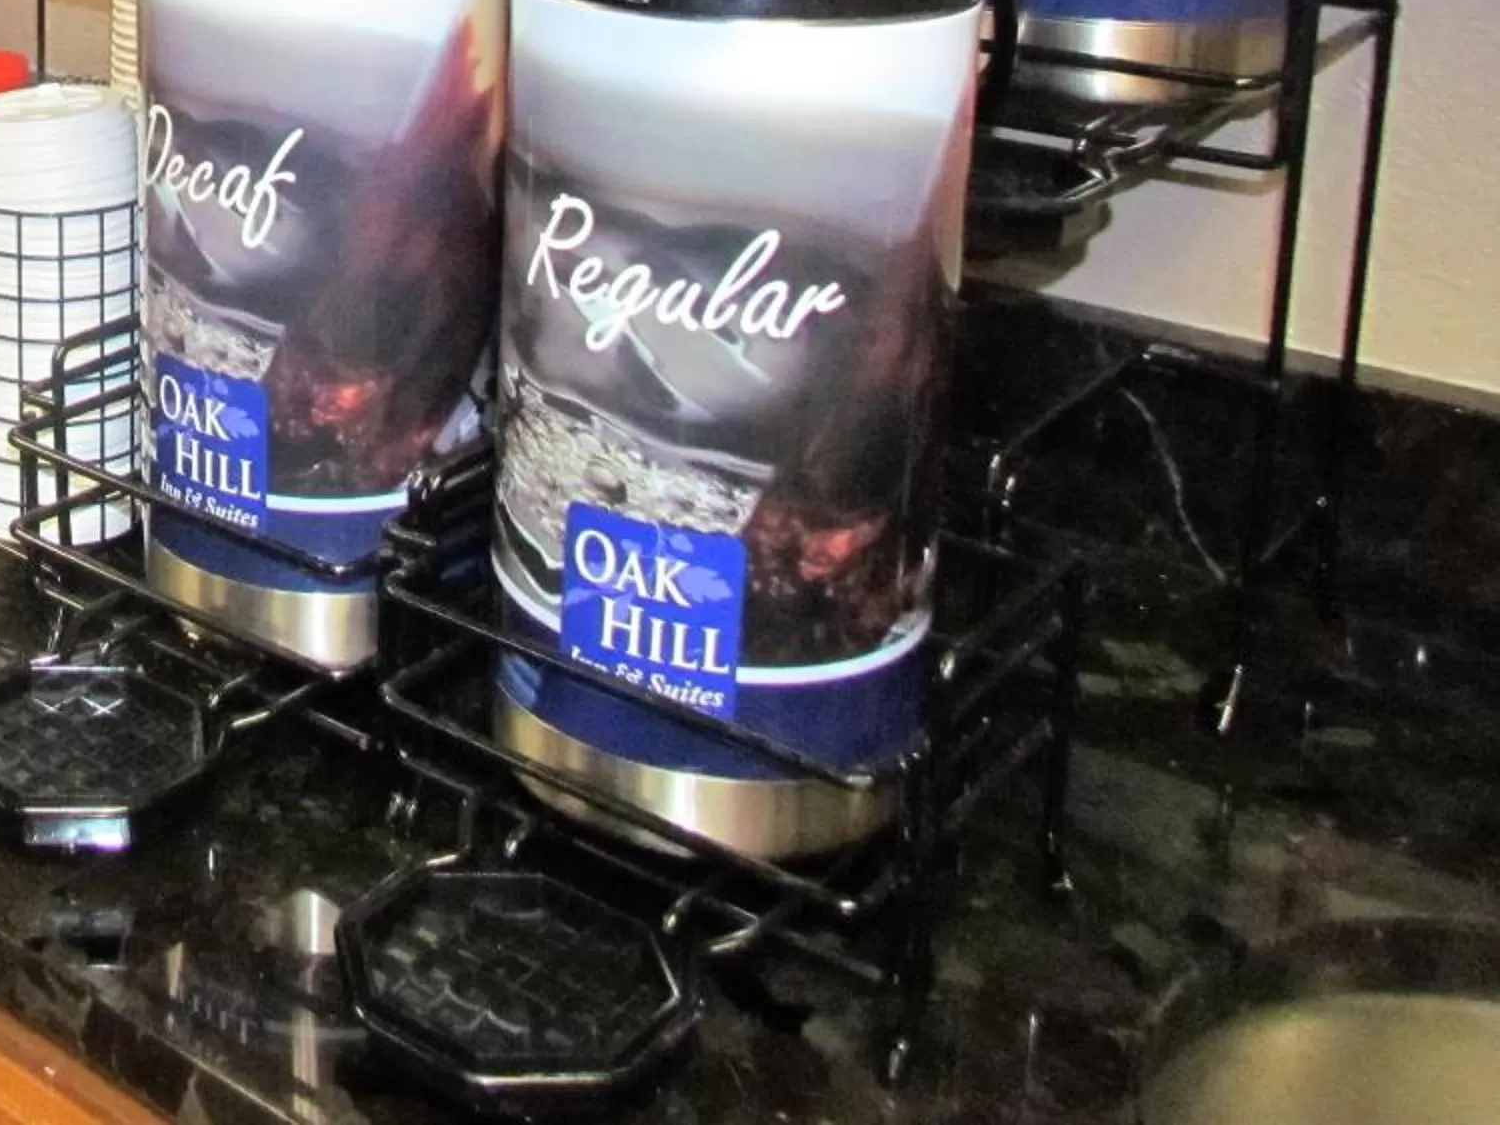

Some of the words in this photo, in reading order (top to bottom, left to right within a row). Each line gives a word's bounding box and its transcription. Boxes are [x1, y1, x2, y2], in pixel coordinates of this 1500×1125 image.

[144, 104, 304, 249] Decaf
[527, 192, 847, 353] Regular
[160, 374, 231, 442] OAK
[175, 429, 262, 501] HILL
[204, 495, 260, 528] Suites
[574, 528, 692, 609] OAK
[600, 594, 731, 676] HILL
[647, 671, 725, 709] Suites
